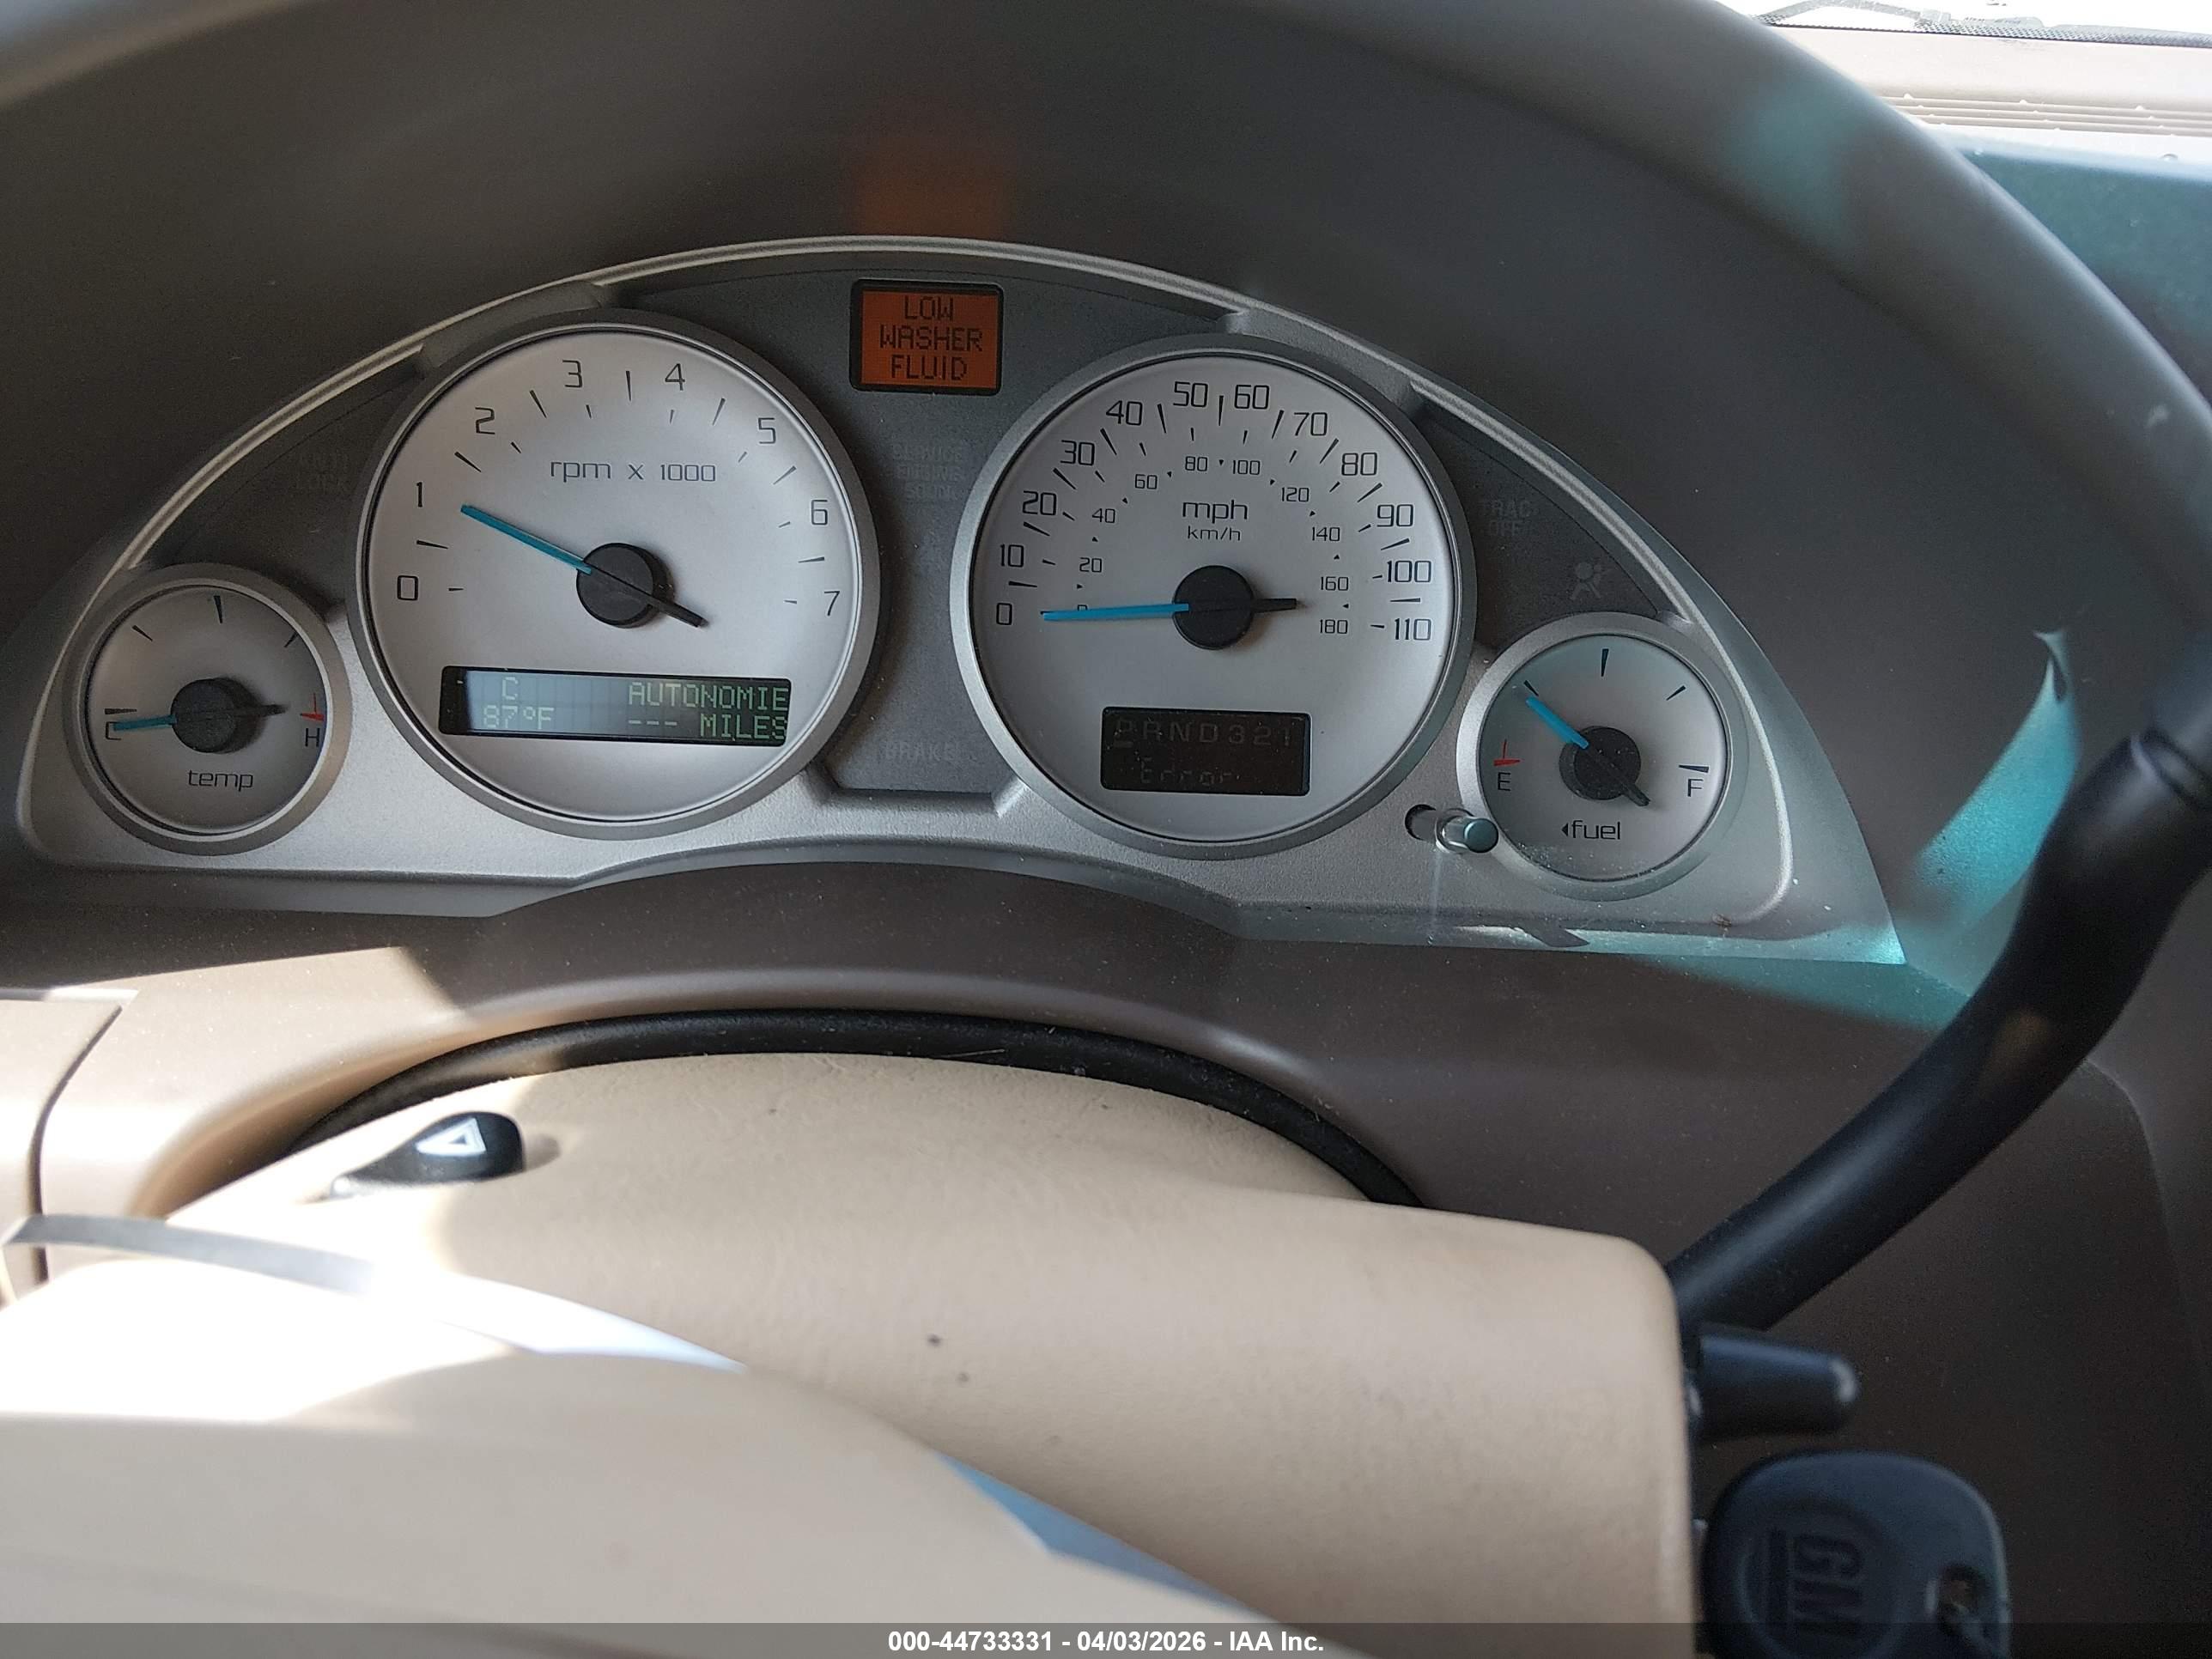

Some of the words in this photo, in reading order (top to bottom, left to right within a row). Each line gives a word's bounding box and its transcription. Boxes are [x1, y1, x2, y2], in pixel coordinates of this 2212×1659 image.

[904, 295, 954, 320] LOW
[880, 325, 982, 352] WASHER
[562, 360, 582, 387] 3
[665, 363, 685, 390] 4
[891, 355, 967, 380] FLUID
[1173, 381, 1208, 407] 50
[1234, 385, 1269, 409] 60
[475, 407, 495, 434] 2
[1106, 400, 1142, 425] 40
[1294, 412, 1328, 435] 70
[758, 417, 775, 443] 5
[1060, 440, 1095, 465] 30
[1185, 456, 1207, 471] 80
[551, 462, 611, 483] rpm
[661, 465, 715, 481] 1000
[1233, 460, 1260, 475] 100
[1341, 453, 1377, 476] 80
[1135, 474, 1158, 489] 60
[1023, 490, 1056, 515] 20
[1282, 488, 1309, 501] 120
[811, 500, 828, 525] 6
[1092, 508, 1115, 523] 40
[1182, 500, 1247, 524] mph
[1377, 504, 1413, 527] 90
[1188, 526, 1240, 540] km/h
[1312, 527, 1340, 541] 140
[1000, 544, 1024, 568] 10
[1079, 557, 1102, 573] 20
[1387, 561, 1431, 582] 100
[398, 575, 418, 601] 0
[1321, 577, 1348, 591] 160
[824, 591, 840, 616] 7
[996, 603, 1012, 625] 0
[1321, 619, 1347, 634] 180
[1395, 618, 1431, 640] 110
[629, 682, 789, 711] AUTONOMIE
[305, 727, 319, 747] H
[700, 714, 787, 740] MILES
[189, 770, 252, 792] temp
[1498, 772, 1510, 791] E
[1687, 779, 1703, 797] F
[1571, 820, 1620, 839] fuel
